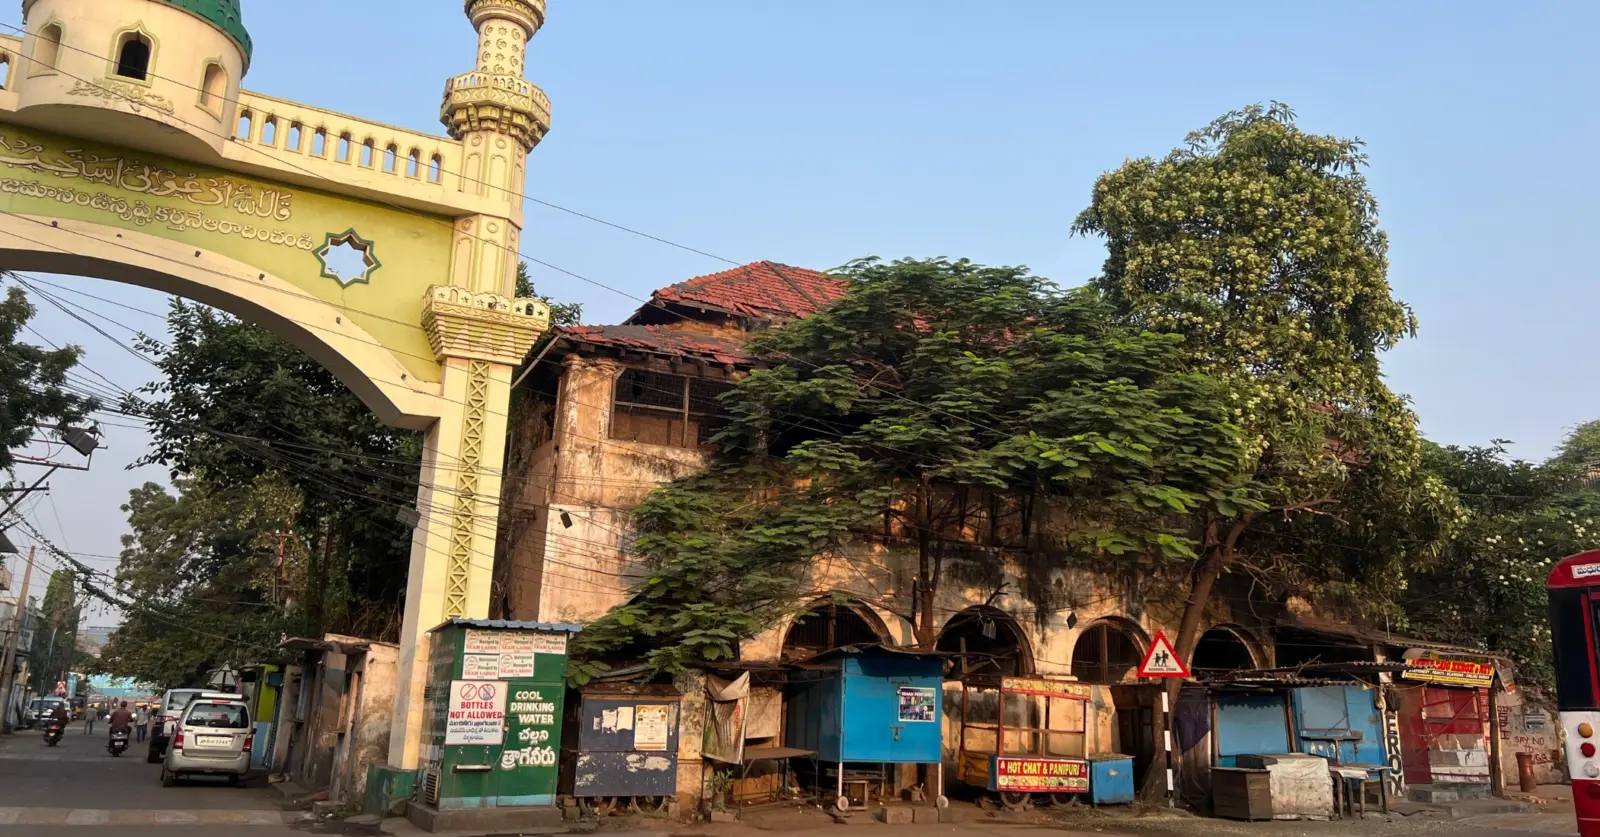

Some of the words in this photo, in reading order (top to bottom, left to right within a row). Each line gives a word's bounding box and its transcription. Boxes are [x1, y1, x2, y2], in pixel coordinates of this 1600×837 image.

[515, 690, 543, 700] COOL
[510, 702, 555, 713] DRINKING
[450, 711, 465, 719] NOT
[467, 711, 503, 719] ALLOWED
[518, 713, 554, 725] WATER
[1514, 735, 1529, 743] SAY
[1532, 736, 1545, 746] NO
[1007, 761, 1021, 774] HOT
[1023, 762, 1042, 775] CHAT
[1043, 763, 1048, 774] &
[1049, 763, 1080, 776] PANIPURI
